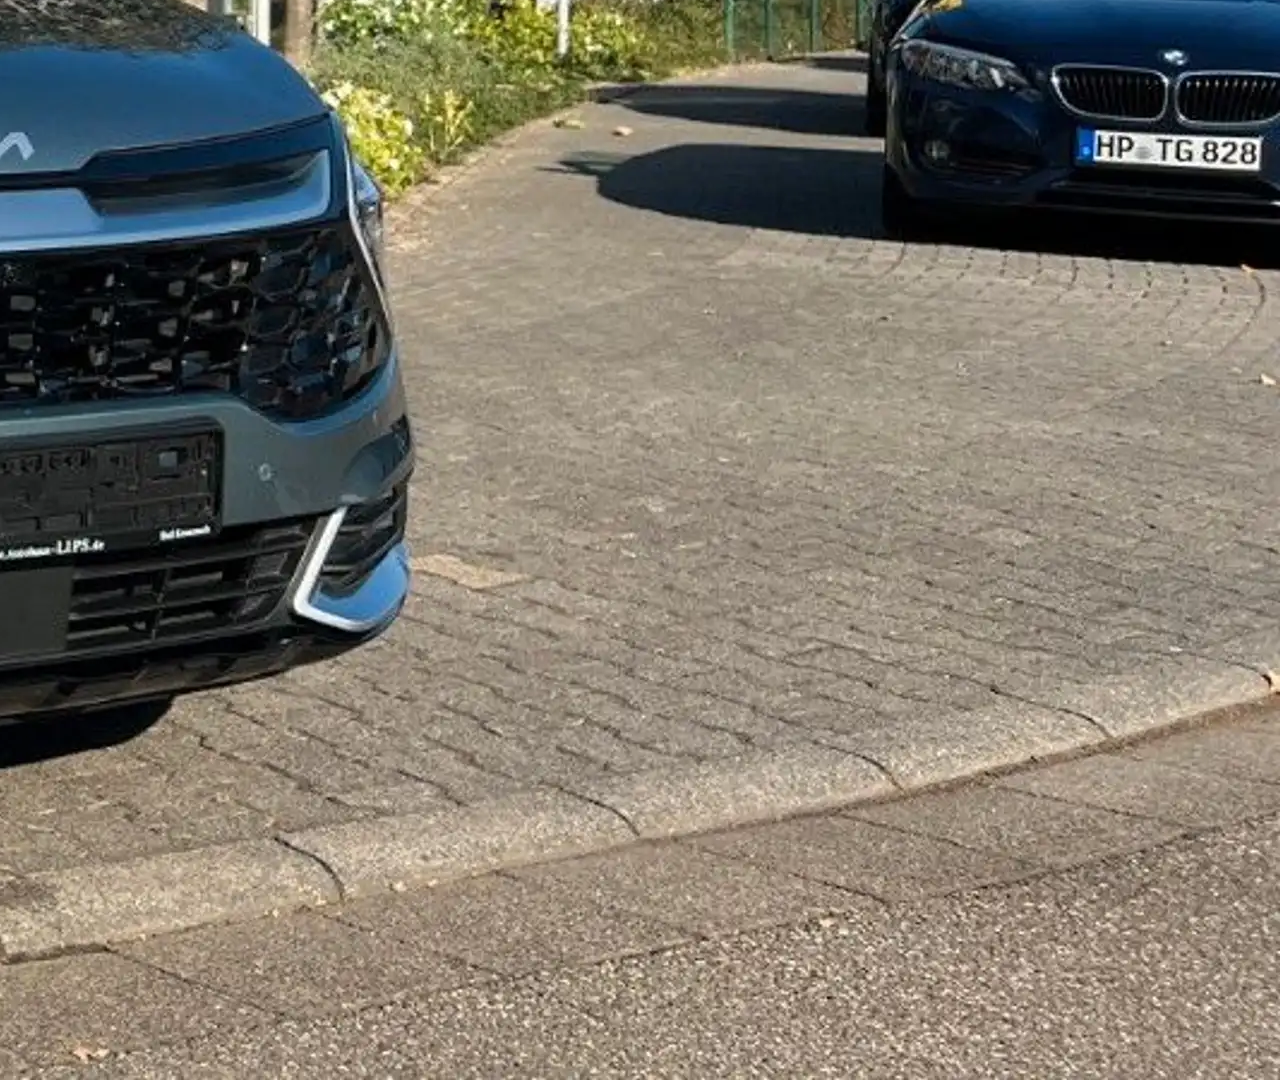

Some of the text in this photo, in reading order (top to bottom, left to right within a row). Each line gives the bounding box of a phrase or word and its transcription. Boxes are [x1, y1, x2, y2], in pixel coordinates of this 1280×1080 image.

[1096, 134, 1258, 166] HP TG 828
